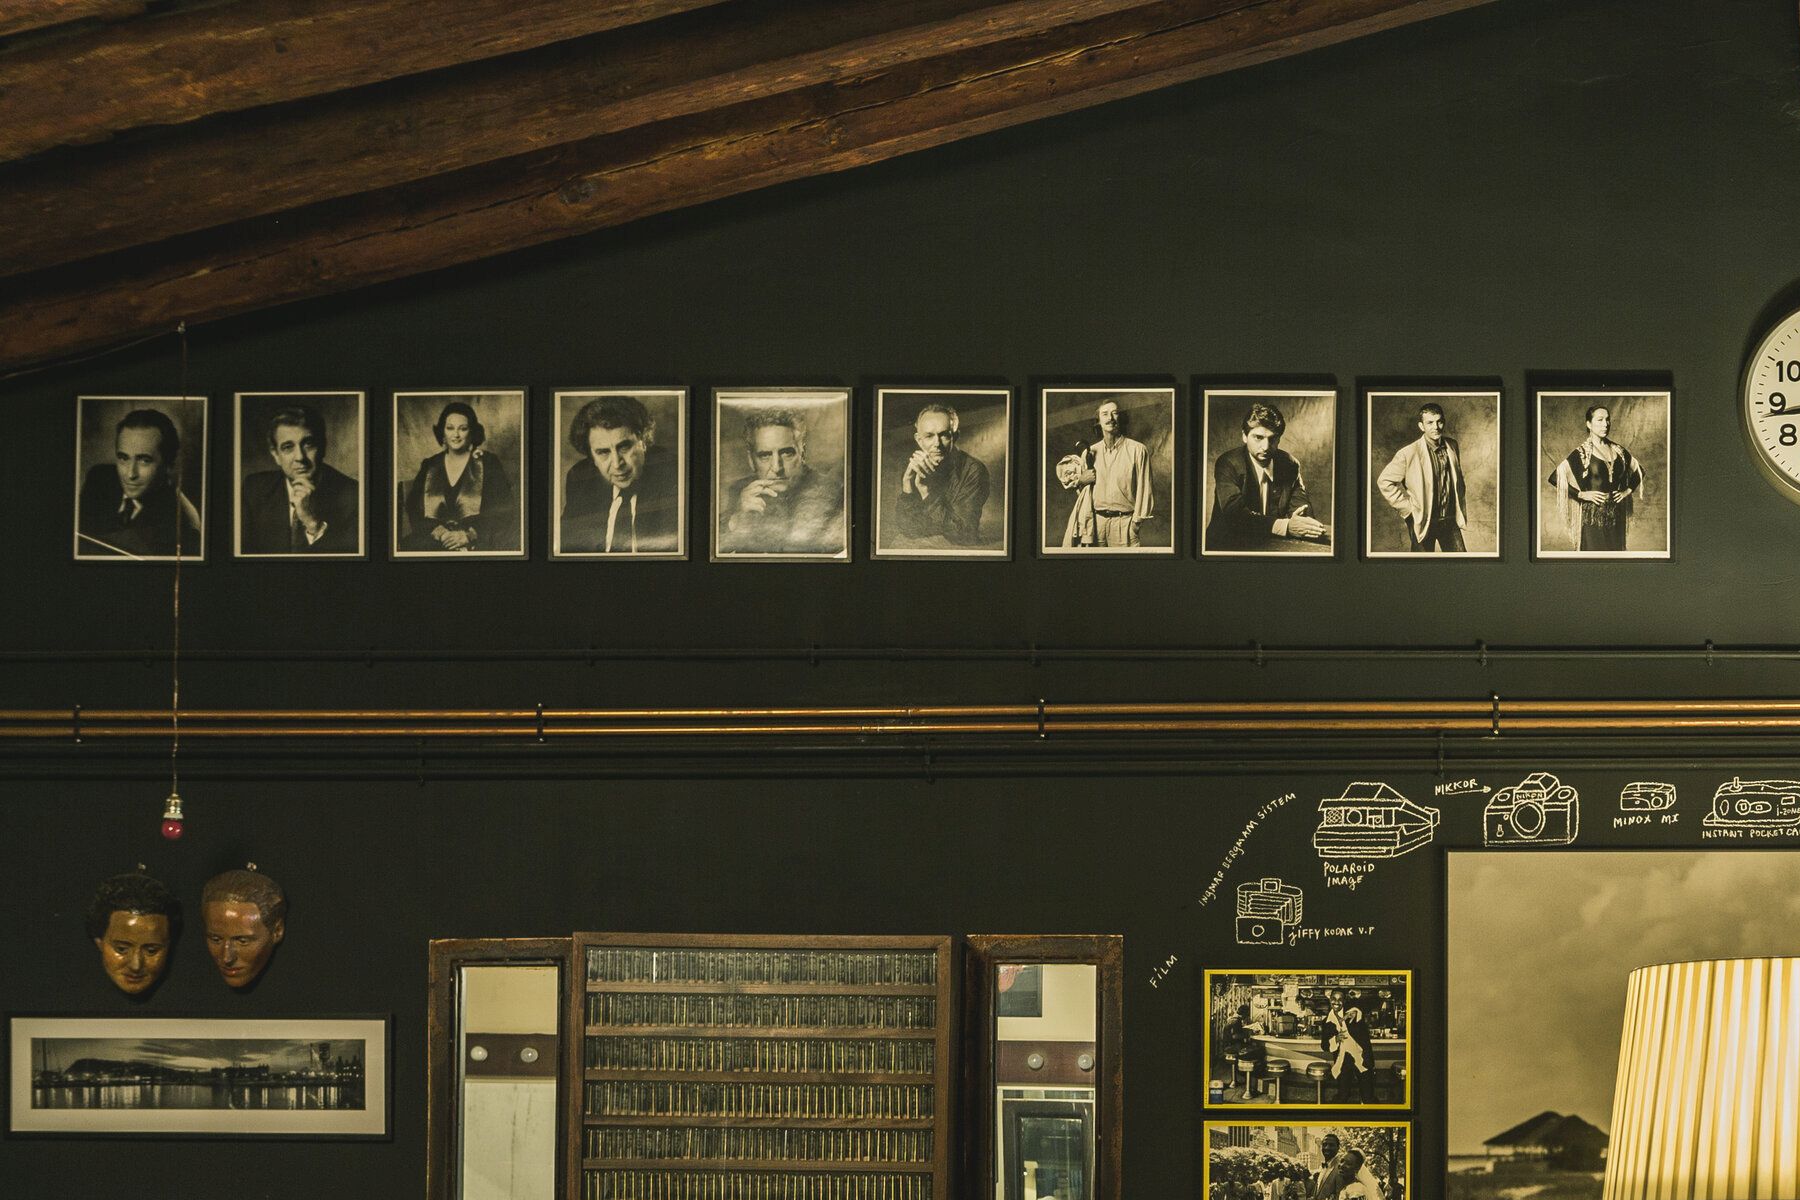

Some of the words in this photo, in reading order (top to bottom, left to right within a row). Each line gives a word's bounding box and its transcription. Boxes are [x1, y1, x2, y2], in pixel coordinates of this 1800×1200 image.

[1769, 392, 1787, 413] 9
[1778, 424, 1798, 446] 8
[1435, 779, 1477, 796] NIKKOR
[1515, 792, 1543, 800] NIKON
[1613, 814, 1651, 828] MINOX
[1702, 829, 1743, 839] INSTANT
[1750, 827, 1784, 838] POCKET
[1323, 861, 1375, 877] POLAROID
